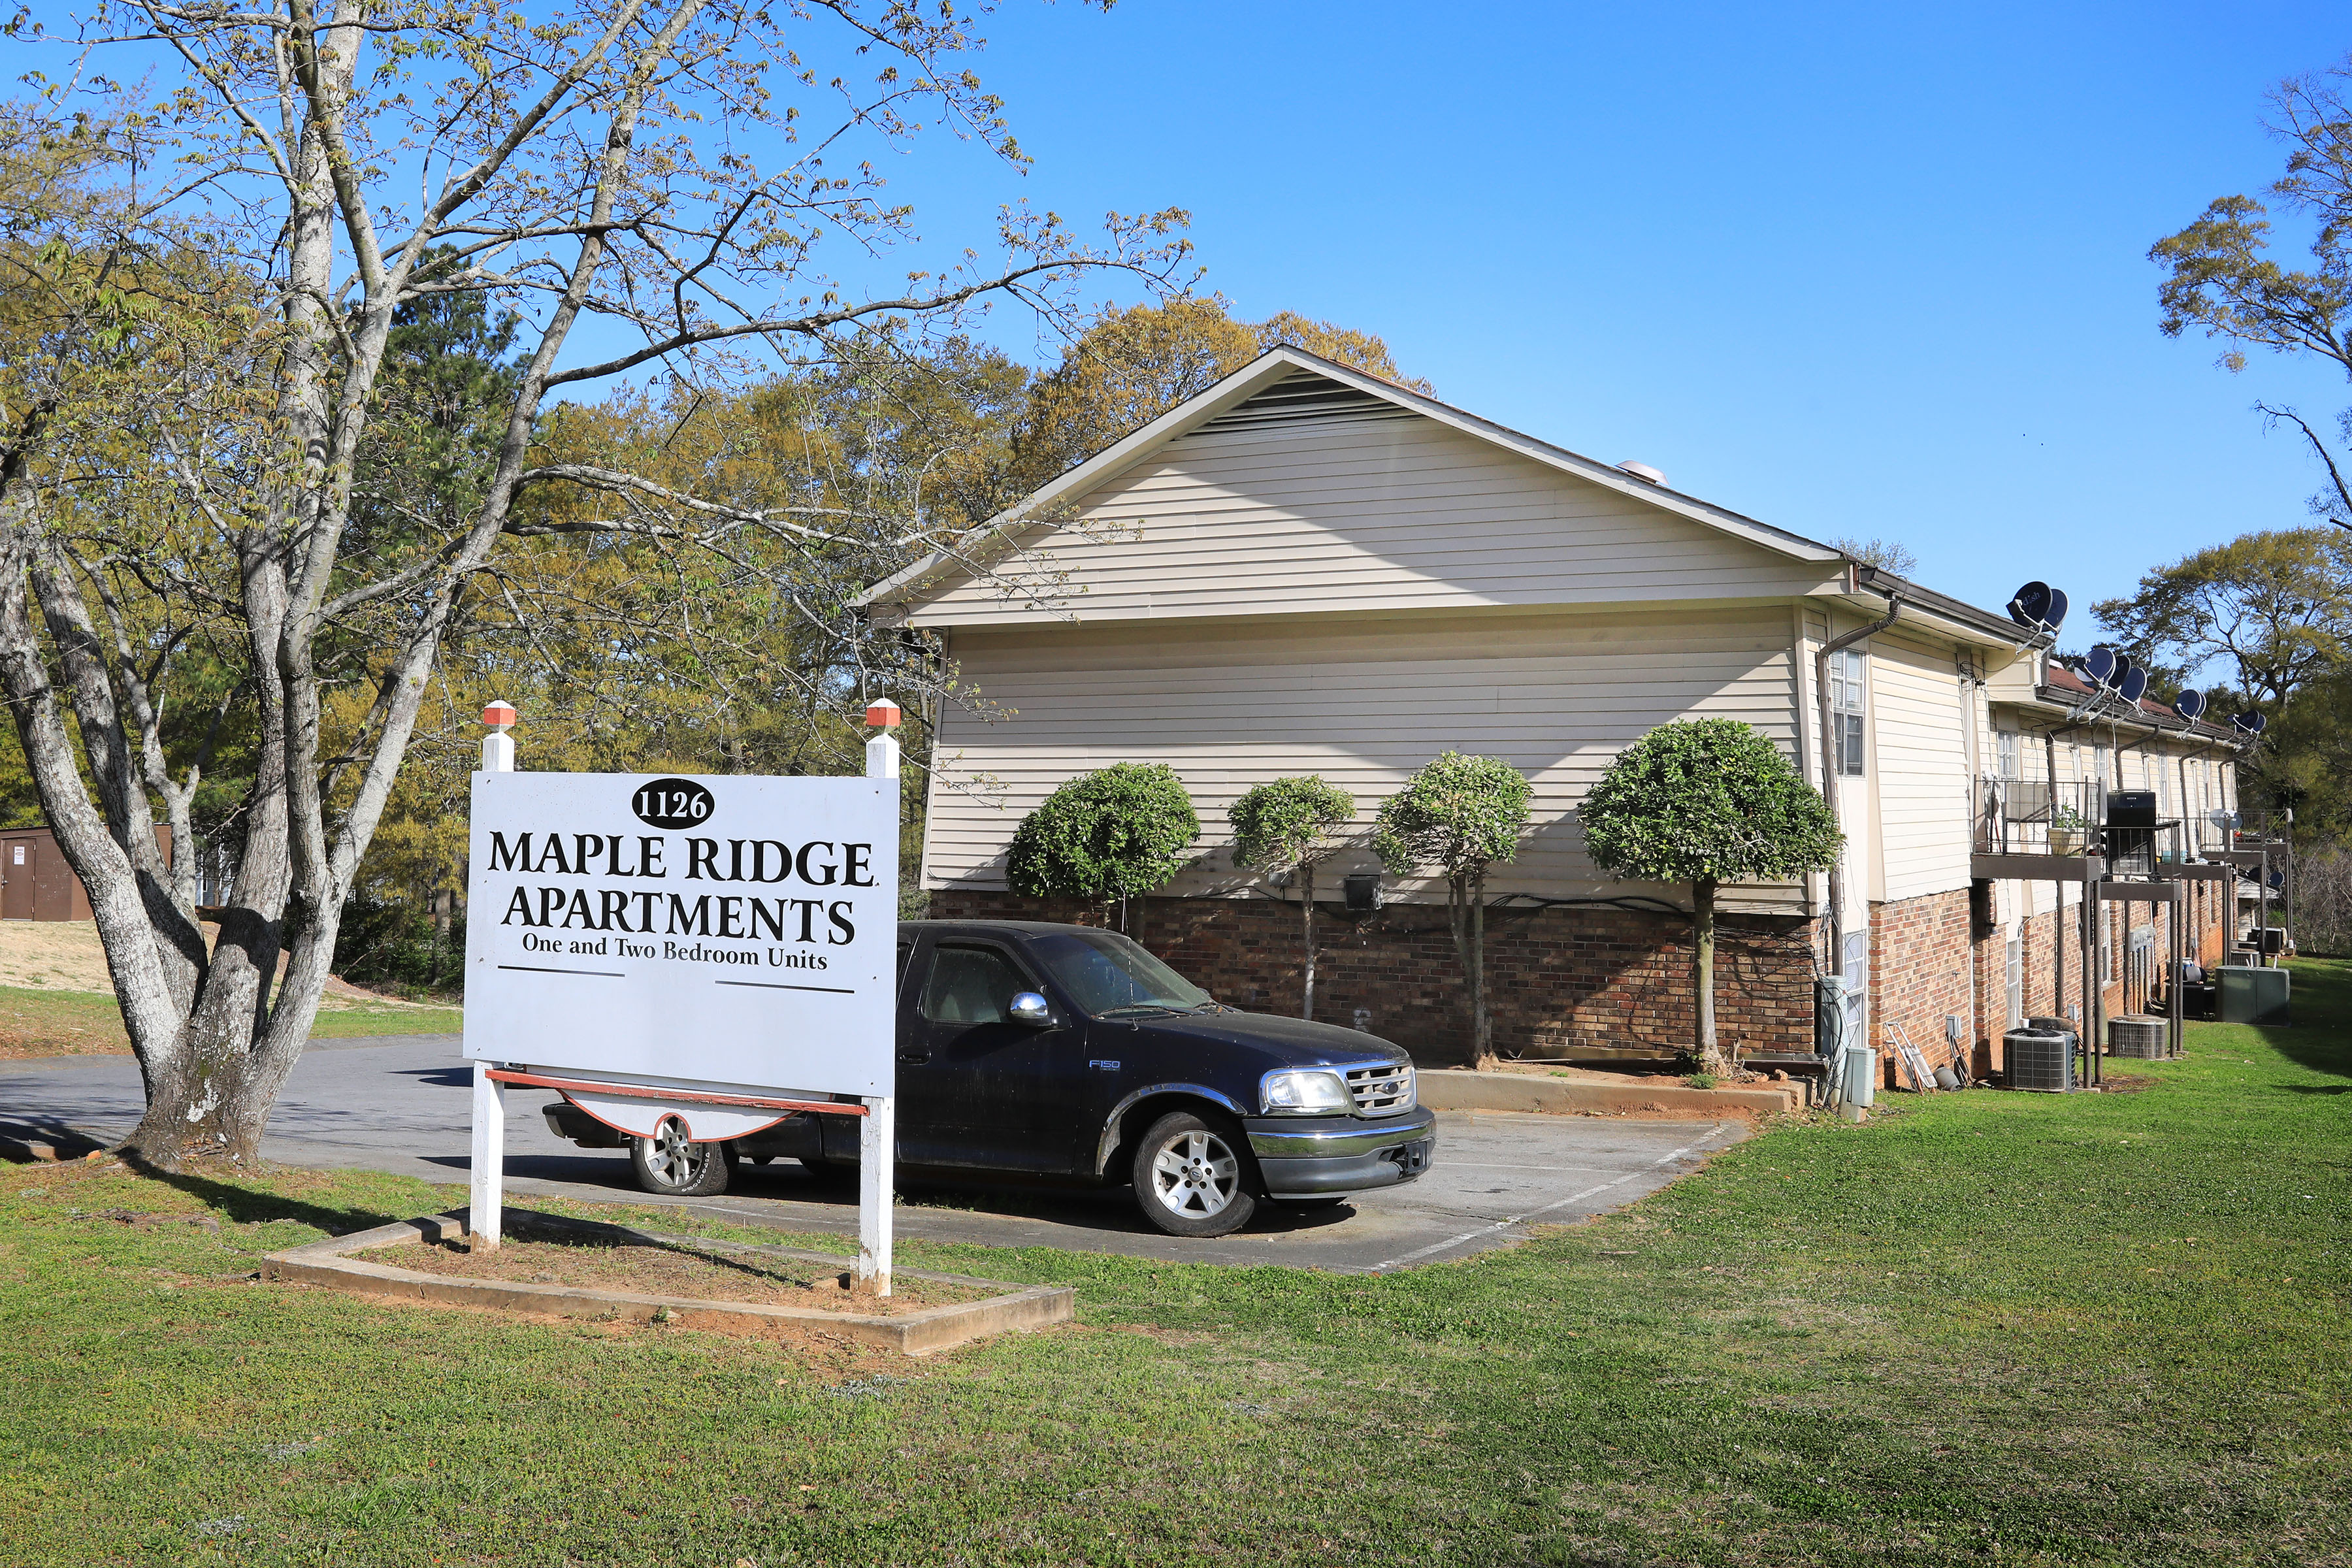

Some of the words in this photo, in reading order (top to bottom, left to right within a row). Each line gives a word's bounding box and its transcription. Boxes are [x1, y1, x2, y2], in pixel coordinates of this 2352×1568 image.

[639, 791, 707, 819] 1126
[488, 831, 667, 878] MAPLE
[685, 837, 874, 887] RIDGE
[500, 886, 855, 945] APARTMENTS
[523, 932, 563, 953] One
[569, 937, 608, 955] and
[614, 938, 656, 959] Two
[663, 941, 759, 966] Bedroom
[767, 947, 828, 970] Units
